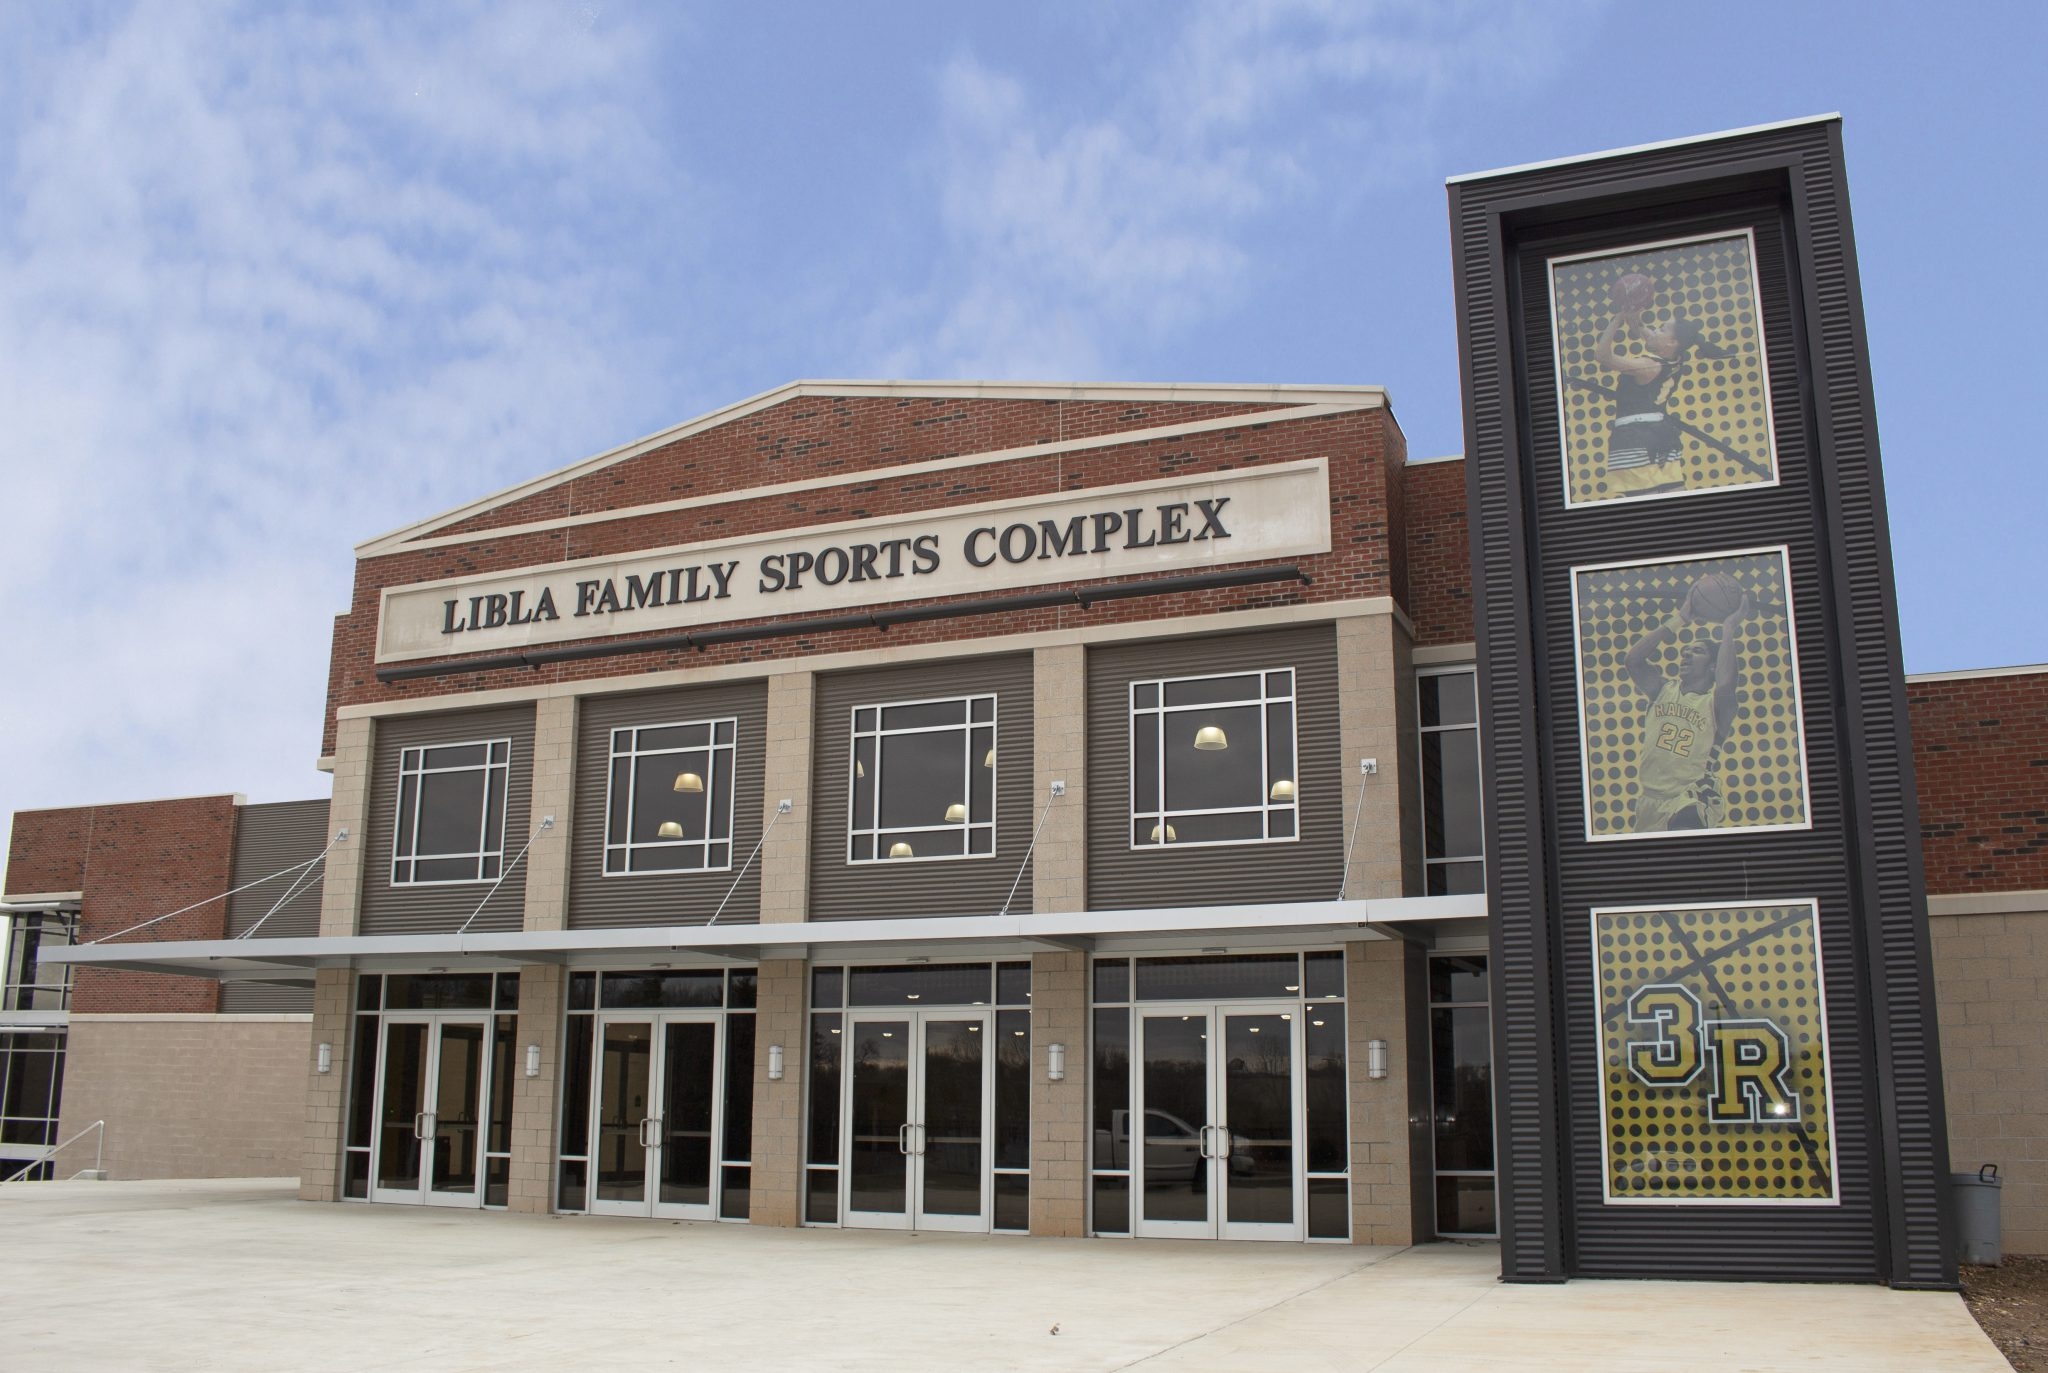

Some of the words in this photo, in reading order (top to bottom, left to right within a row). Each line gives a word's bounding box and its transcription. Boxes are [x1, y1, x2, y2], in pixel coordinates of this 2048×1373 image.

[441, 587, 560, 634] LIBLA
[573, 561, 740, 616] FAMILY
[759, 535, 940, 593] SPORTS
[963, 497, 1232, 568] COMPLEX
[1657, 722, 1695, 758] 22
